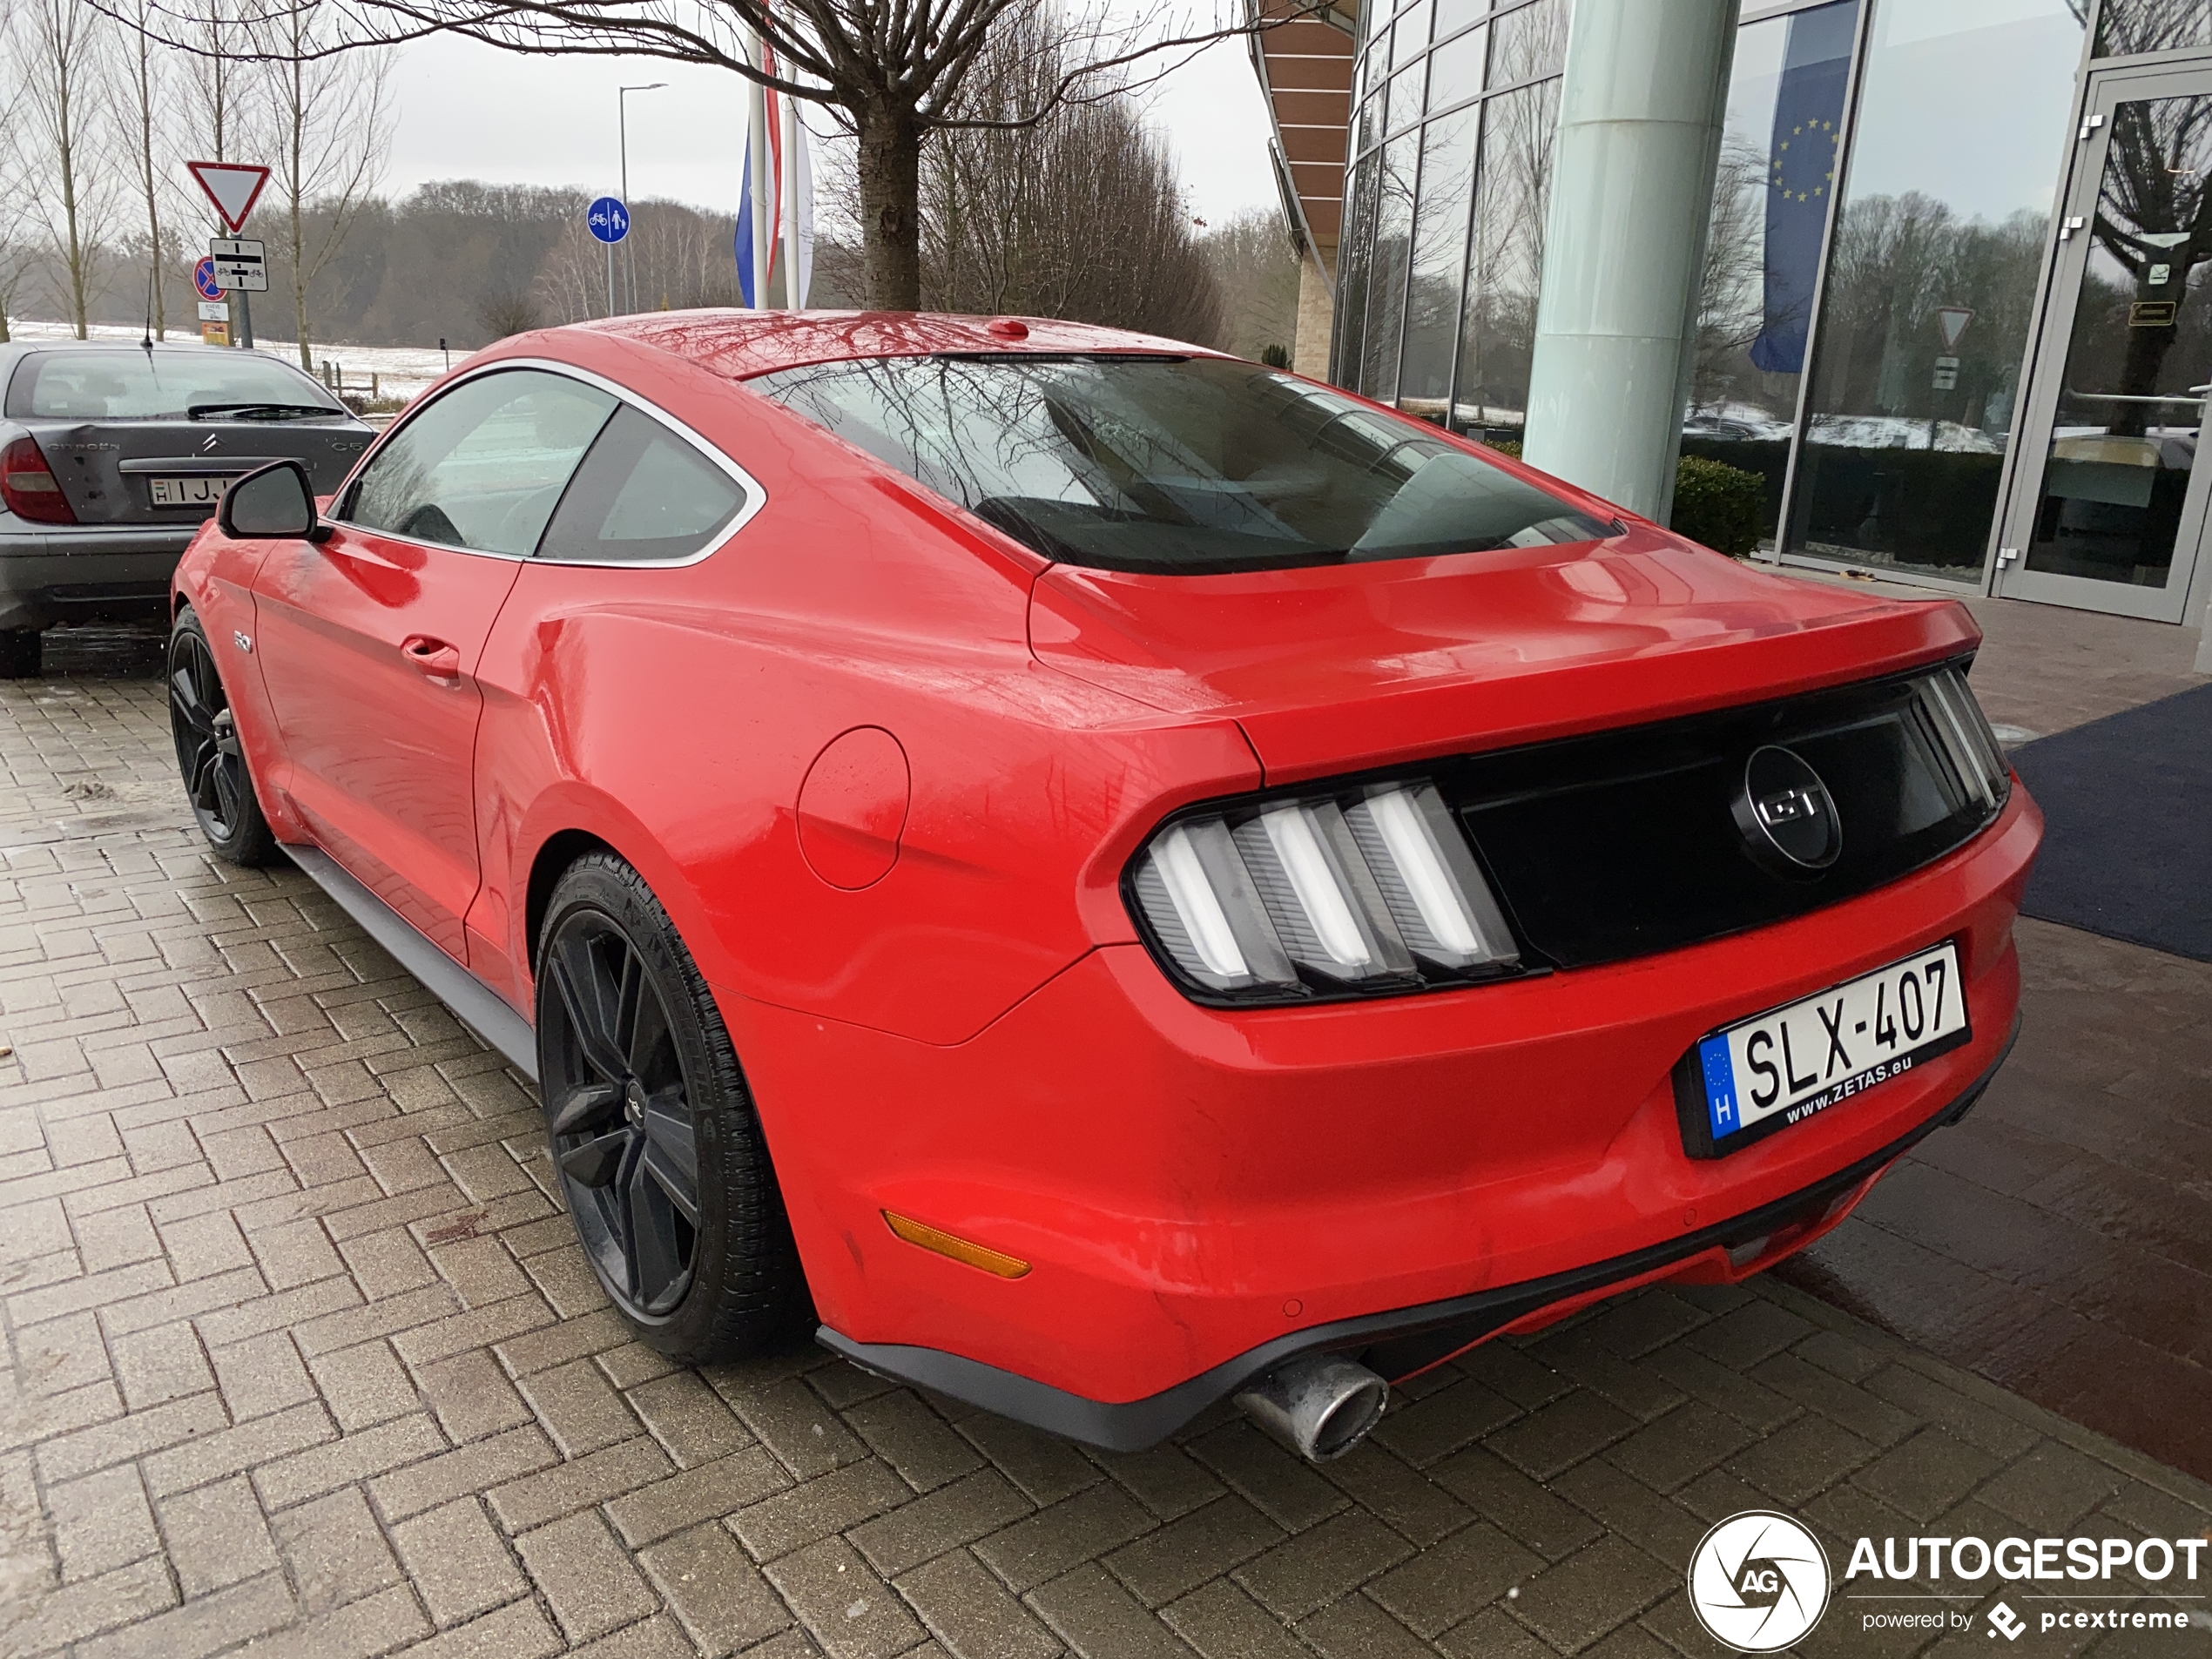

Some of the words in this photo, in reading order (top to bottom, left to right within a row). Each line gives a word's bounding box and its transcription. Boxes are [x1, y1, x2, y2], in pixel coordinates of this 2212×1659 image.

[331, 442, 363, 452] C5
[156, 491, 167, 502] H
[1759, 787, 1820, 826] GT
[1715, 1094, 1731, 1124] H
[1746, 958, 1946, 1109] SLX-407
[1787, 1056, 1912, 1123] www.ZETAS.eu
